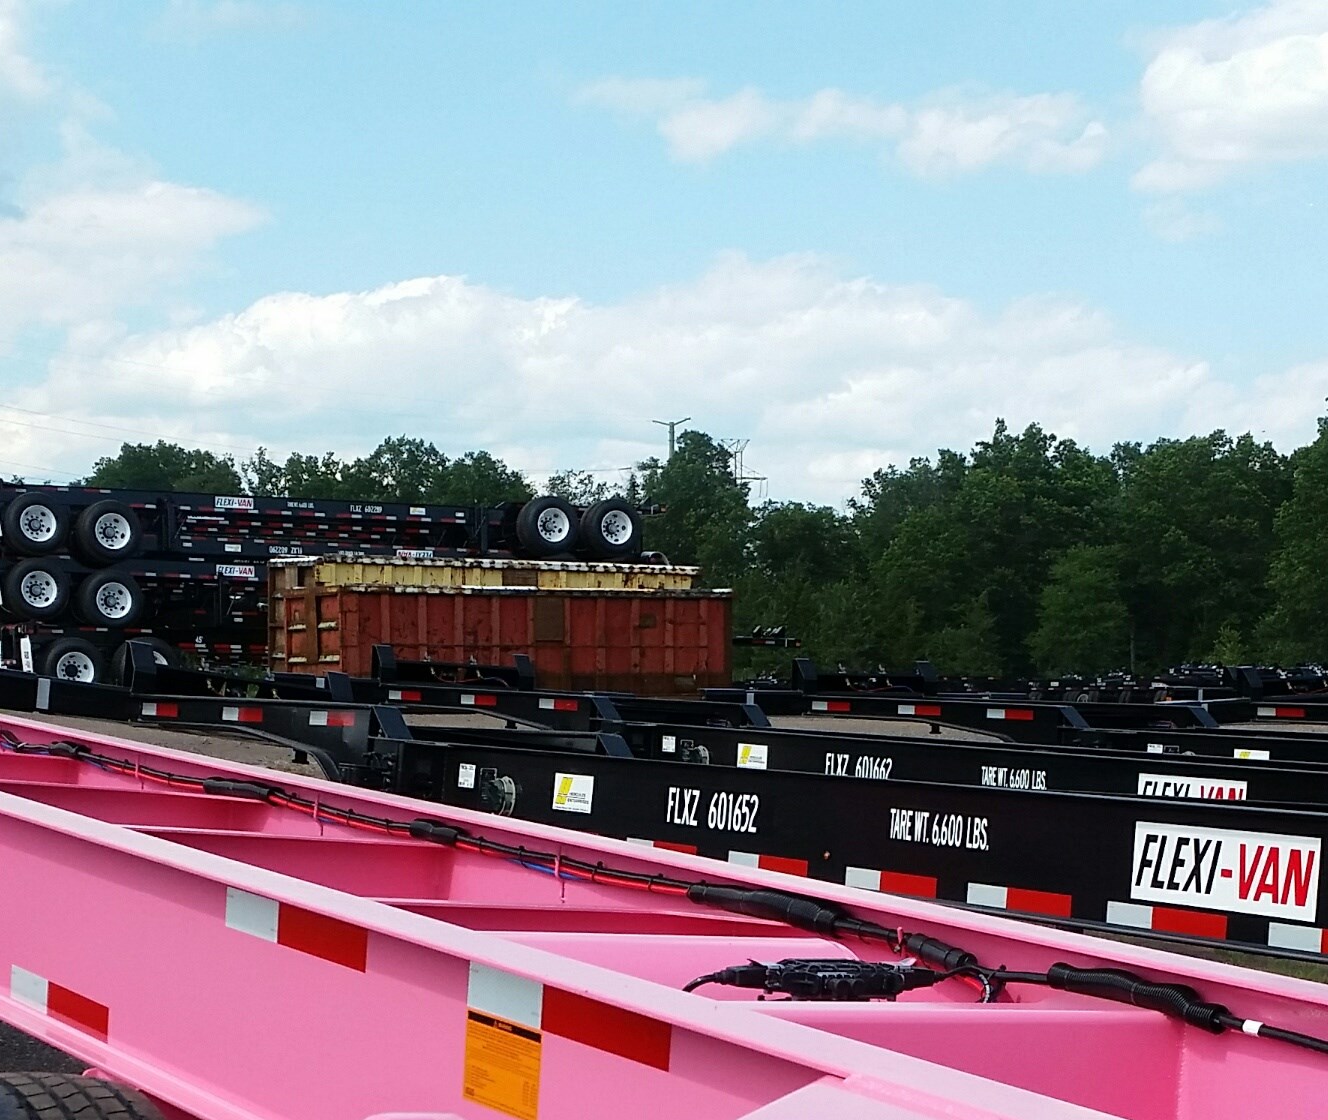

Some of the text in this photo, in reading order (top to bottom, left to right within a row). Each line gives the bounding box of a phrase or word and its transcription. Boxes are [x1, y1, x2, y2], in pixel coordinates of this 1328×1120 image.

[216, 497, 253, 508] FLEXI-VAN
[981, 765, 997, 786] TARE
[1031, 771, 1048, 791] LBS.
[666, 787, 759, 833] FLXZ 601652
[890, 808, 990, 850] TARE WT. 6,600 LBS.
[1134, 833, 1316, 907] FLEXI-VAN
